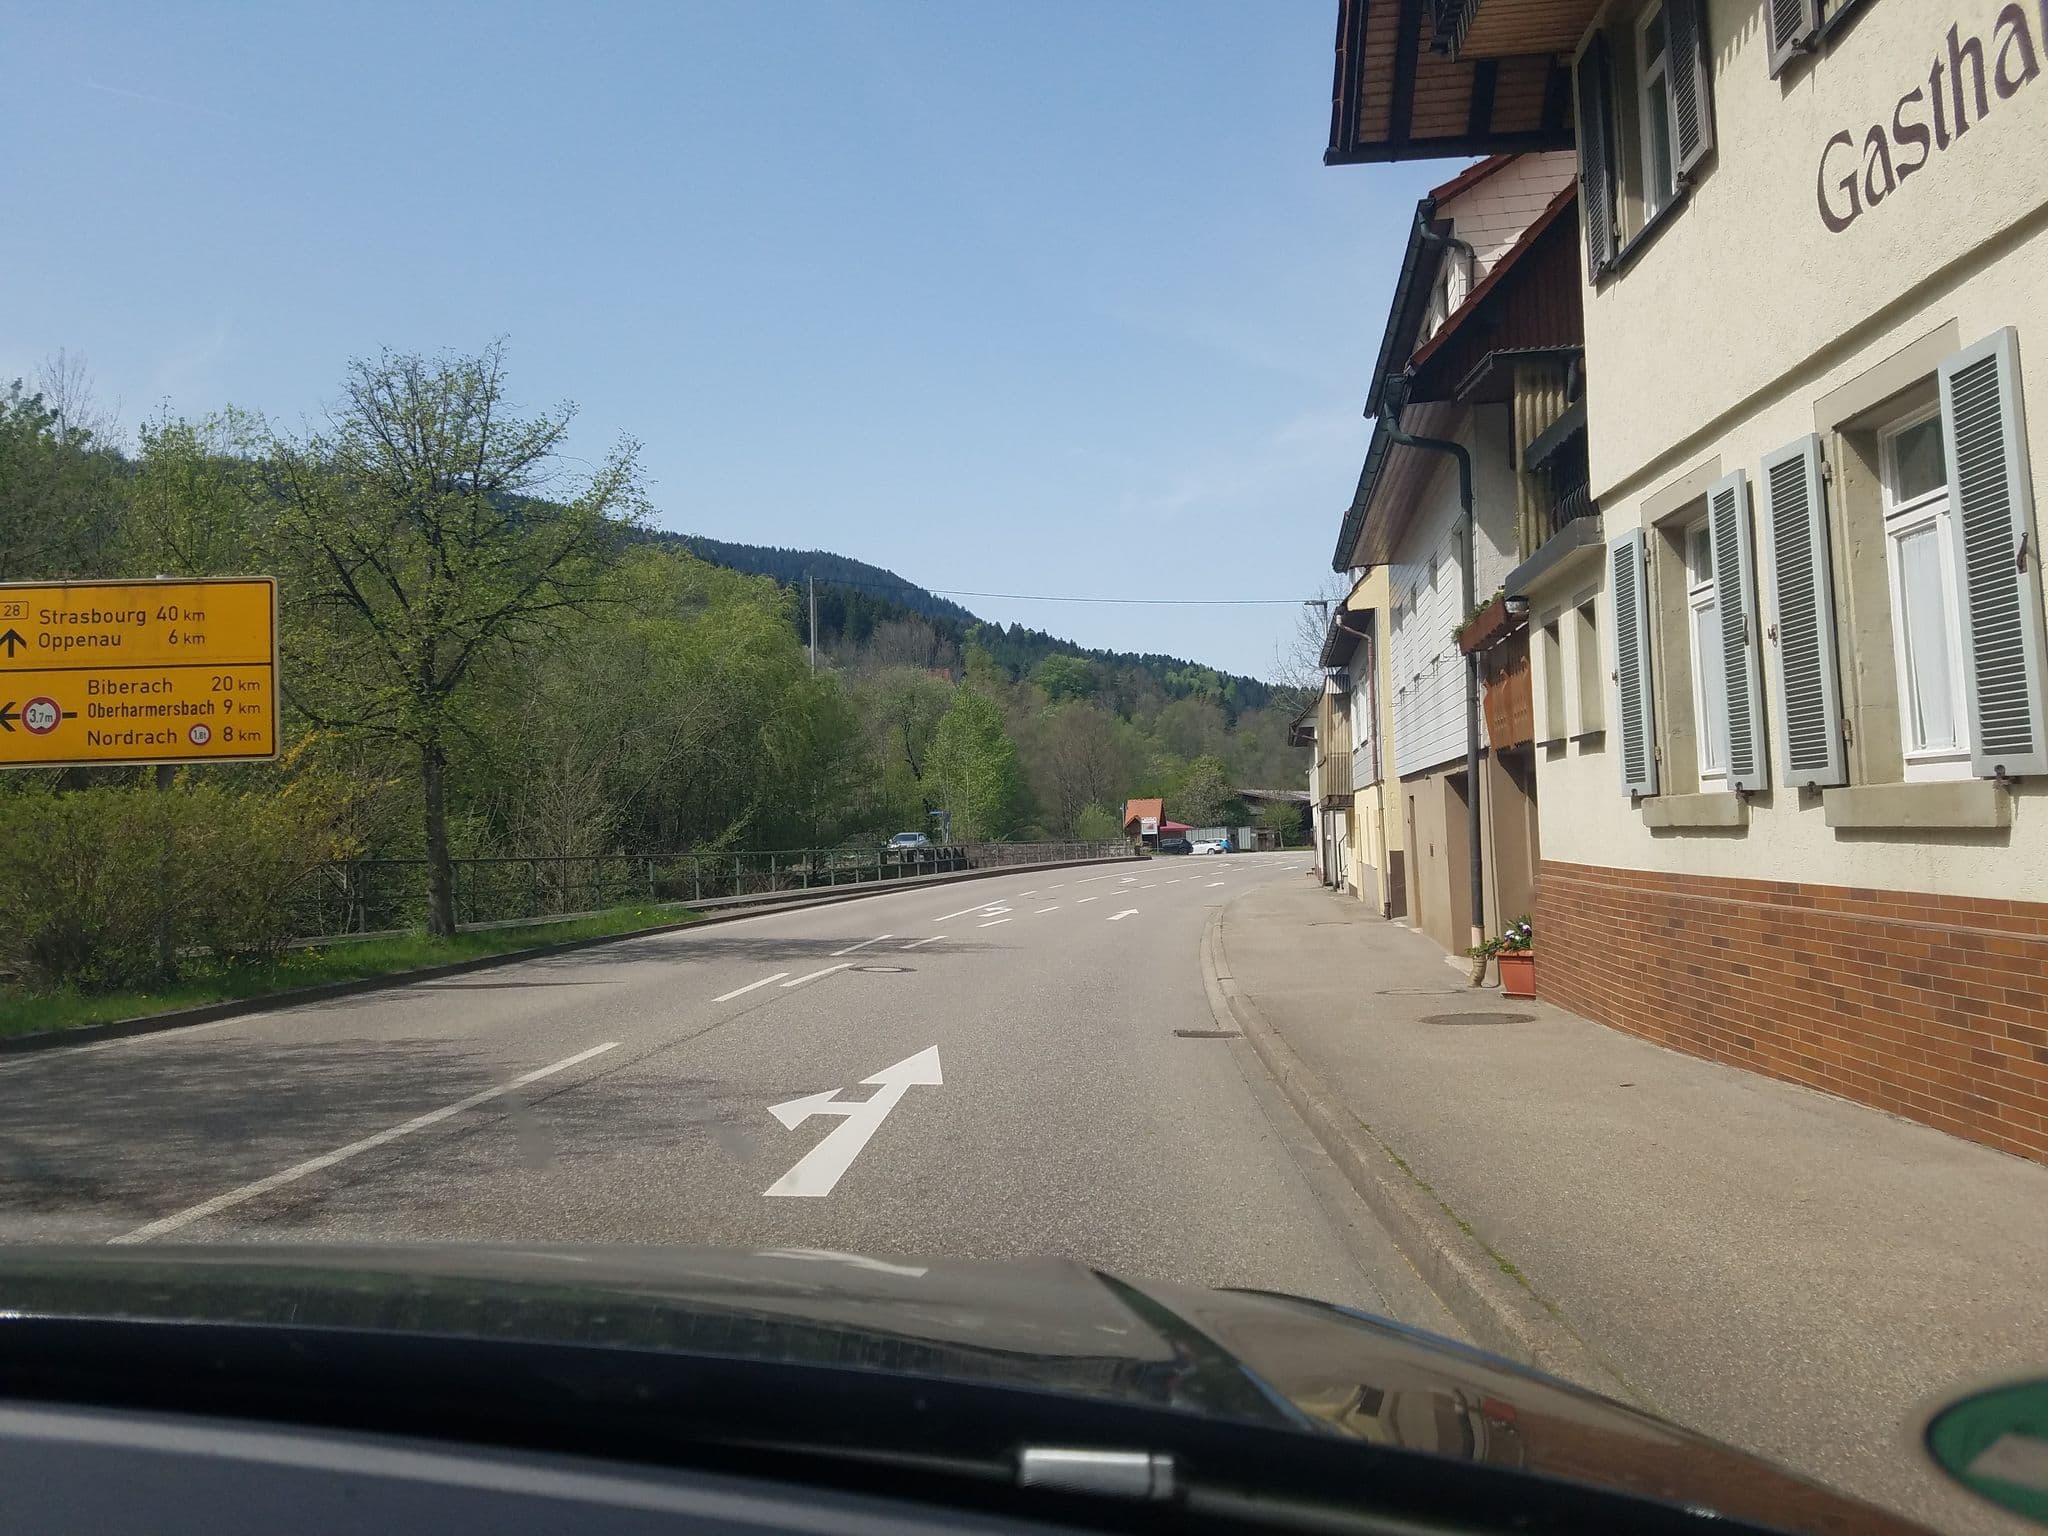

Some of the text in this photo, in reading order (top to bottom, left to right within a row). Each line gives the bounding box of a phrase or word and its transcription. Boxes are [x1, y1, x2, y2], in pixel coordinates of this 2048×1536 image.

[5, 604, 21, 617] 28
[39, 605, 206, 626] Strasbourg 40 km
[38, 628, 206, 651] Oppenau 6 km
[87, 675, 261, 695] Biberach 20 km
[87, 699, 261, 718] Oberharmersbach 9 km
[87, 726, 262, 746] Nordrach 8 km
